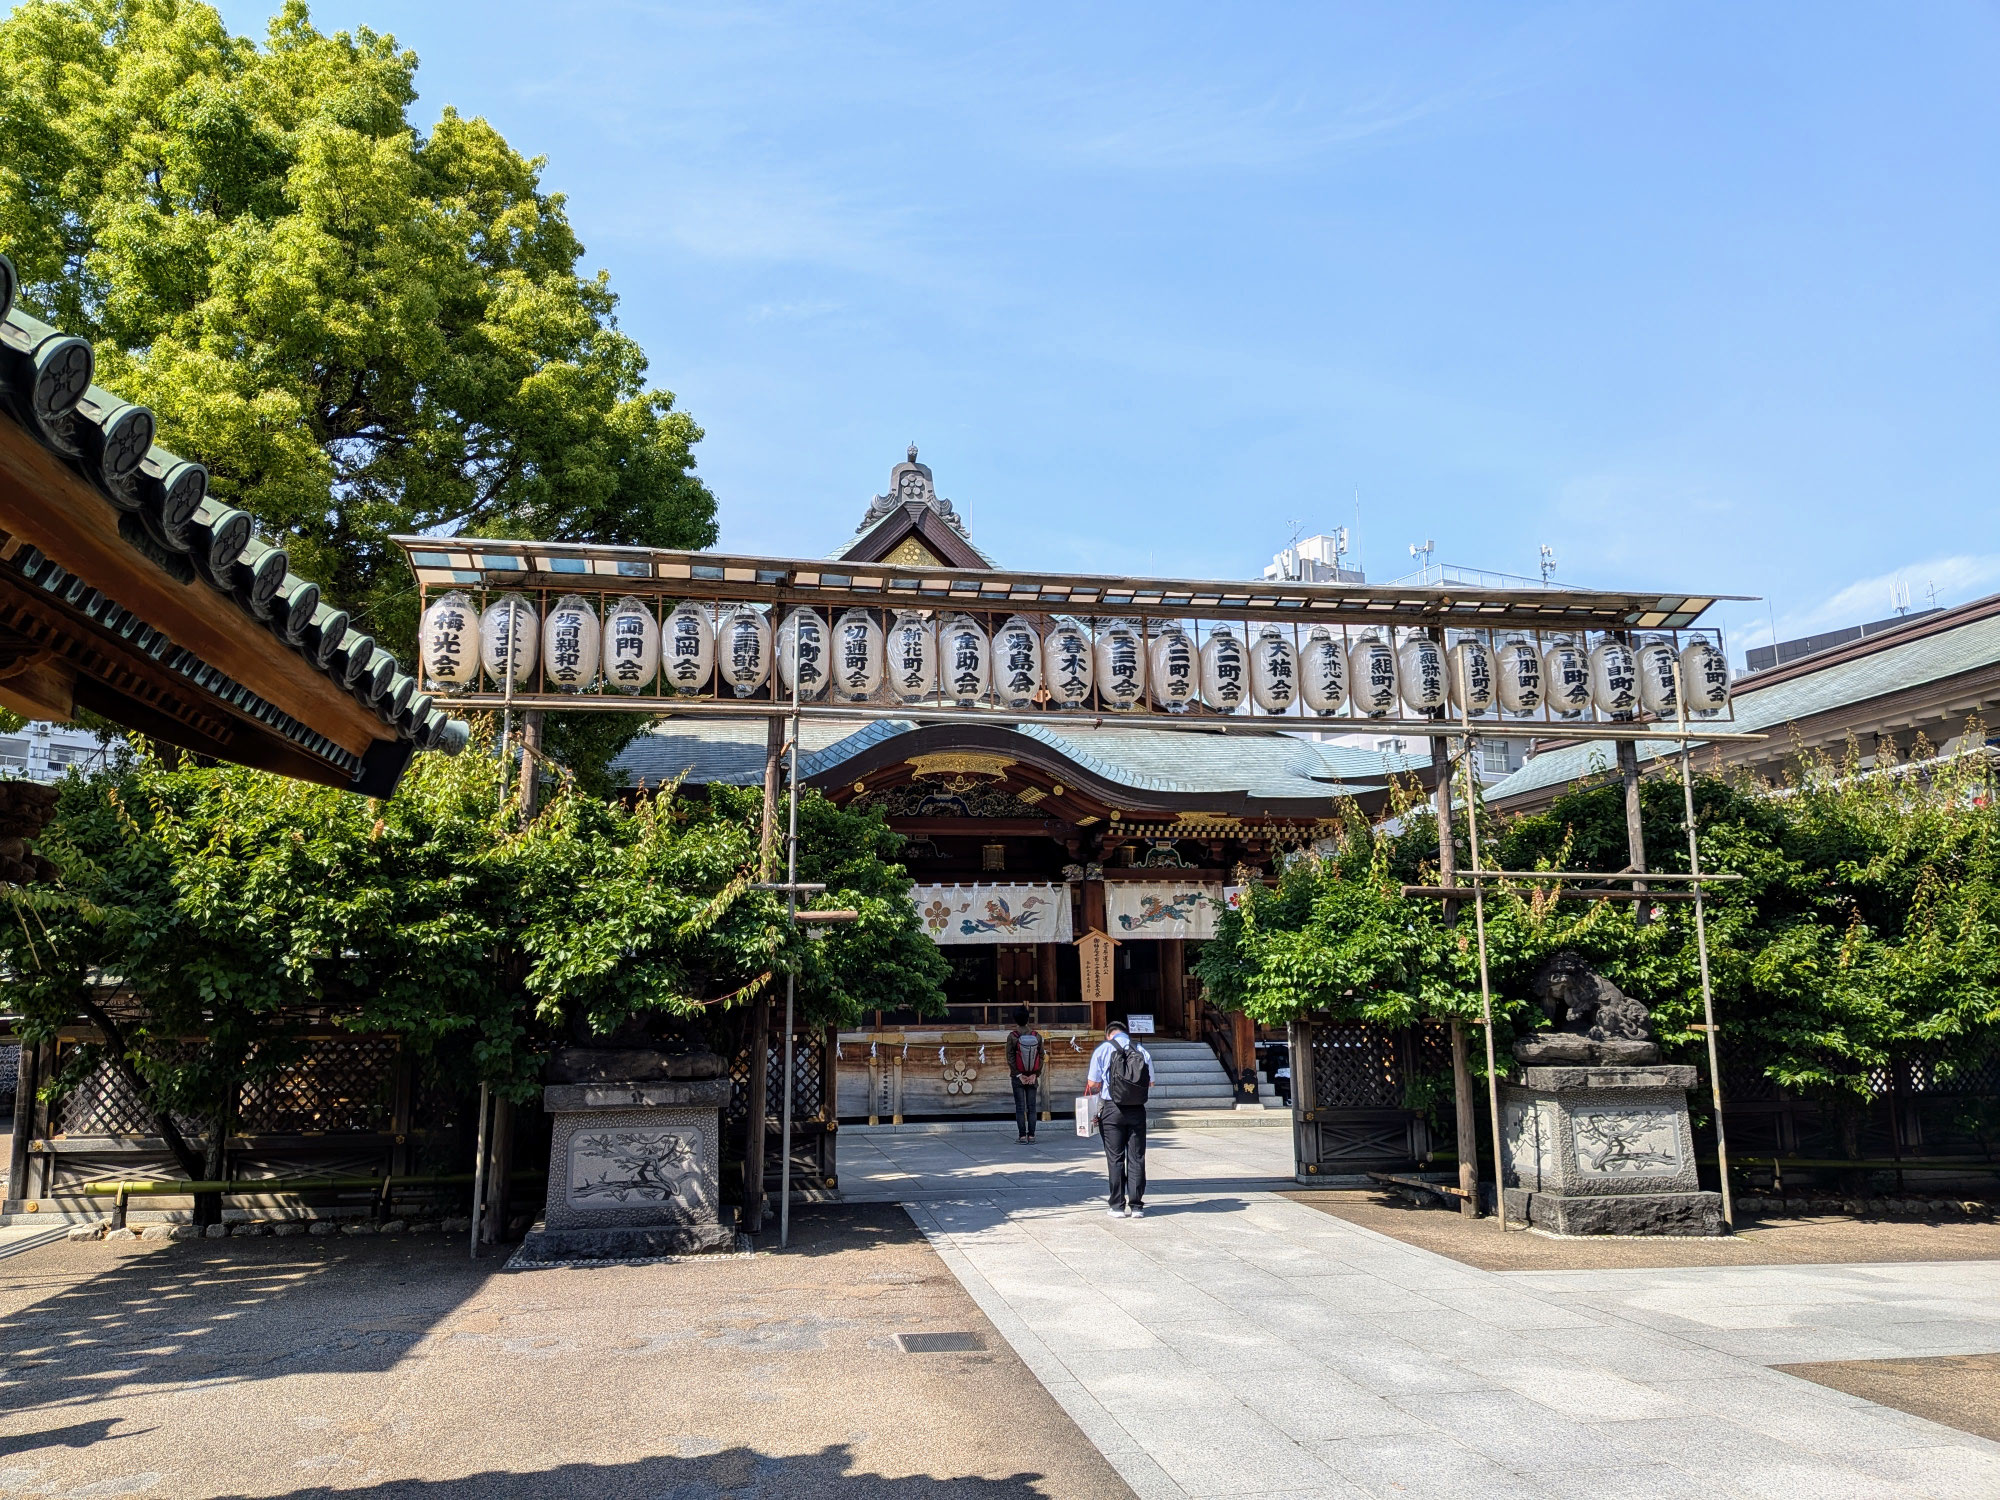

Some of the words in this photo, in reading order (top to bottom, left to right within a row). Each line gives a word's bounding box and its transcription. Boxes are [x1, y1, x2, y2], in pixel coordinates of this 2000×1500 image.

[433, 611, 465, 676] 梅光会
[615, 615, 643, 681] 両門会
[673, 615, 701, 681] 竜岡会
[902, 628, 925, 688] 新花町会
[1006, 633, 1035, 693] 湯島会
[1059, 635, 1088, 698] 春木会
[1111, 636, 1140, 697] 天三町会
[1167, 635, 1190, 697] 天二町会
[1217, 638, 1241, 701] 天一町会
[1267, 640, 1293, 702] 天梅会
[1320, 643, 1343, 701] 妻恋会
[1418, 642, 1441, 703] 三組弥生会
[1370, 645, 1395, 707] 三組町会
[1516, 646, 1540, 707] 同朋町会
